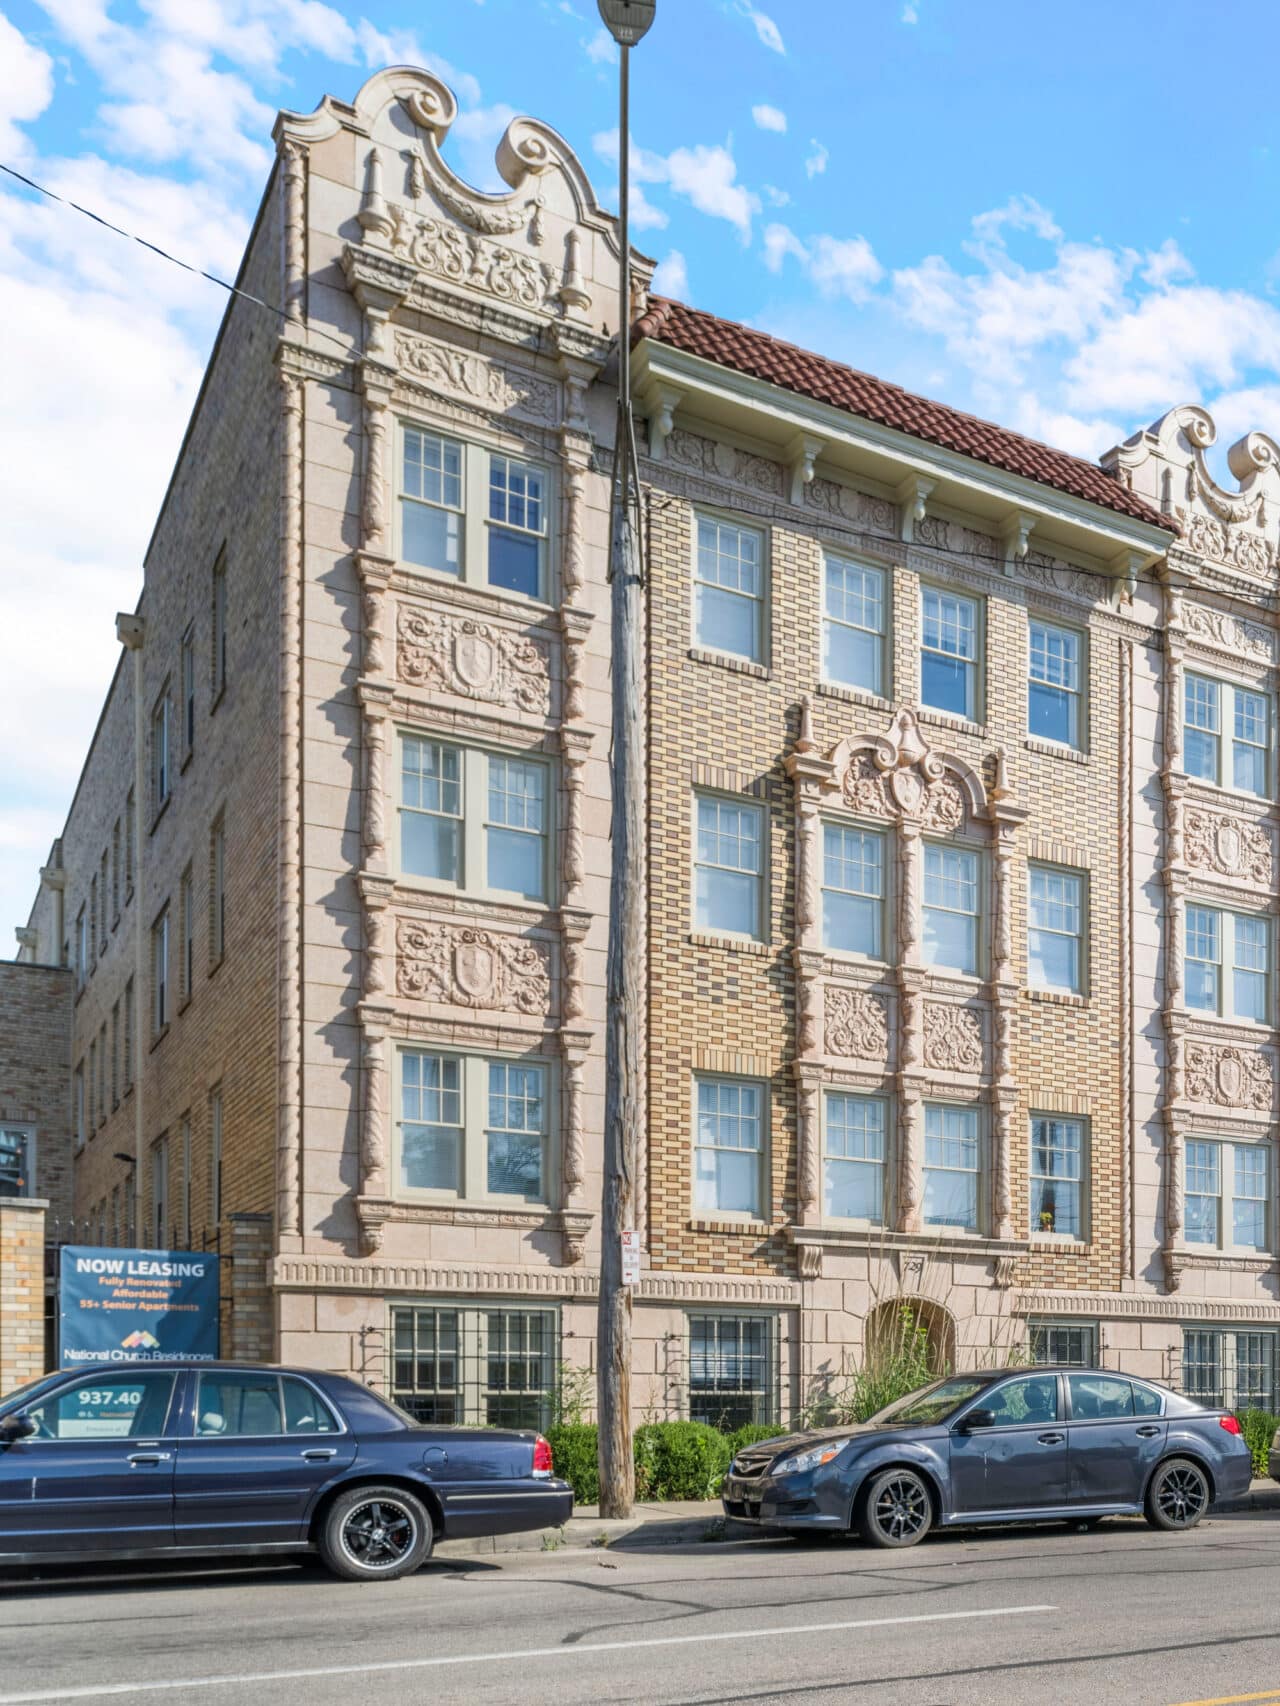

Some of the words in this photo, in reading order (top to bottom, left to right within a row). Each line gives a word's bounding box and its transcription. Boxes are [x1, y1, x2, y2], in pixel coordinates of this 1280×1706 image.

[76, 1258, 125, 1274] NOW
[127, 1261, 205, 1277] LEASING
[98, 1276, 125, 1287] Fully
[126, 1278, 182, 1288] Renovated
[112, 1288, 169, 1299] Affordable
[80, 1300, 100, 1309] 55+
[102, 1300, 137, 1310] Senior
[138, 1301, 200, 1312] Apartments
[64, 1349, 109, 1360] National
[111, 1350, 151, 1361] Church
[152, 1351, 214, 1361] Residences
[78, 1391, 141, 1405] 937.40
